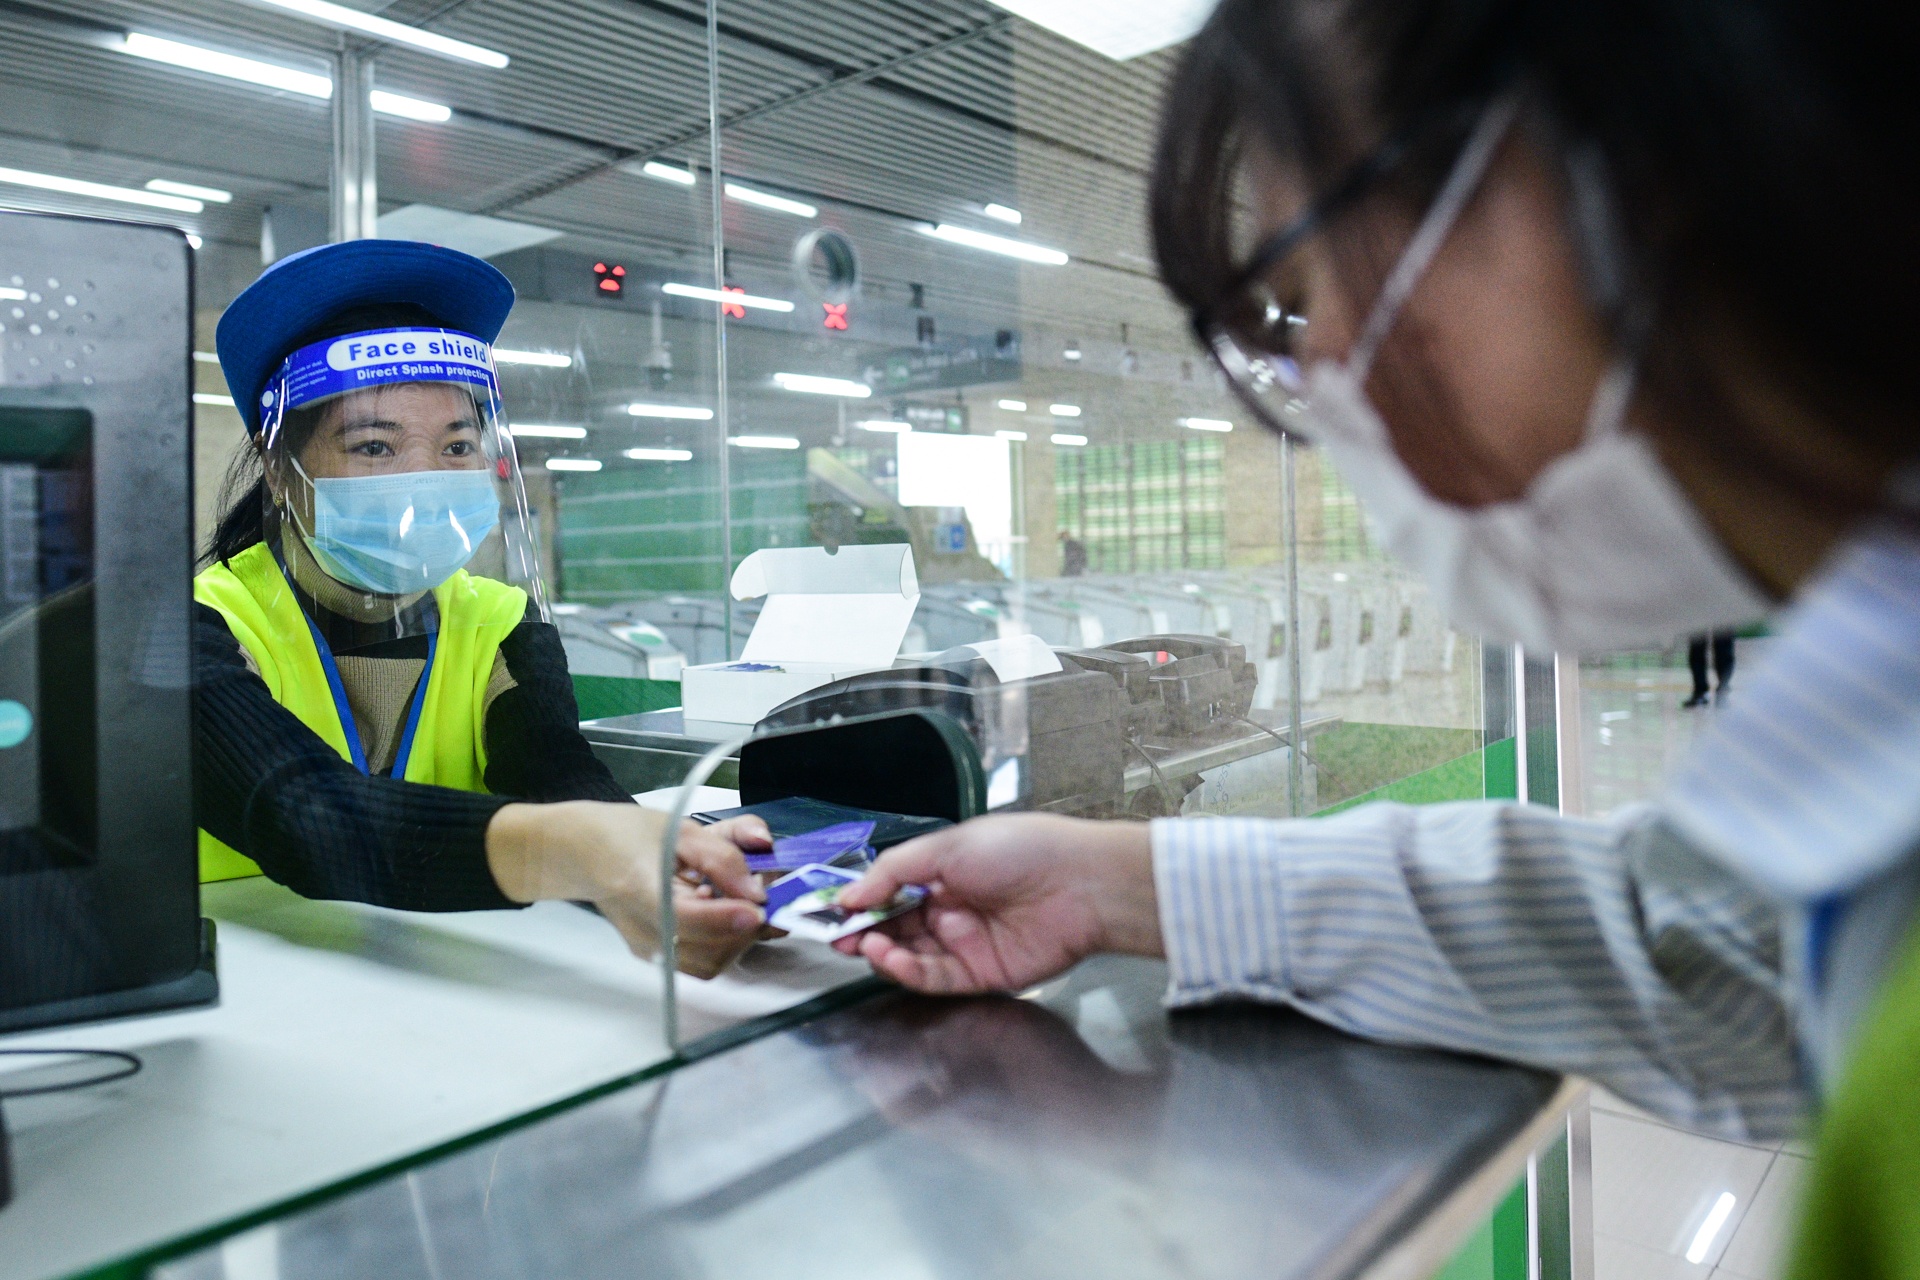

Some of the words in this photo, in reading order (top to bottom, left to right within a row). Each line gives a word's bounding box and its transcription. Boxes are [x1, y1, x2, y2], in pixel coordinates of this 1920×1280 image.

[348, 341, 416, 362] Face
[428, 339, 487, 363] shield
[356, 365, 398, 380] Direct
[401, 364, 444, 376] Splash
[446, 366, 490, 381] protection
